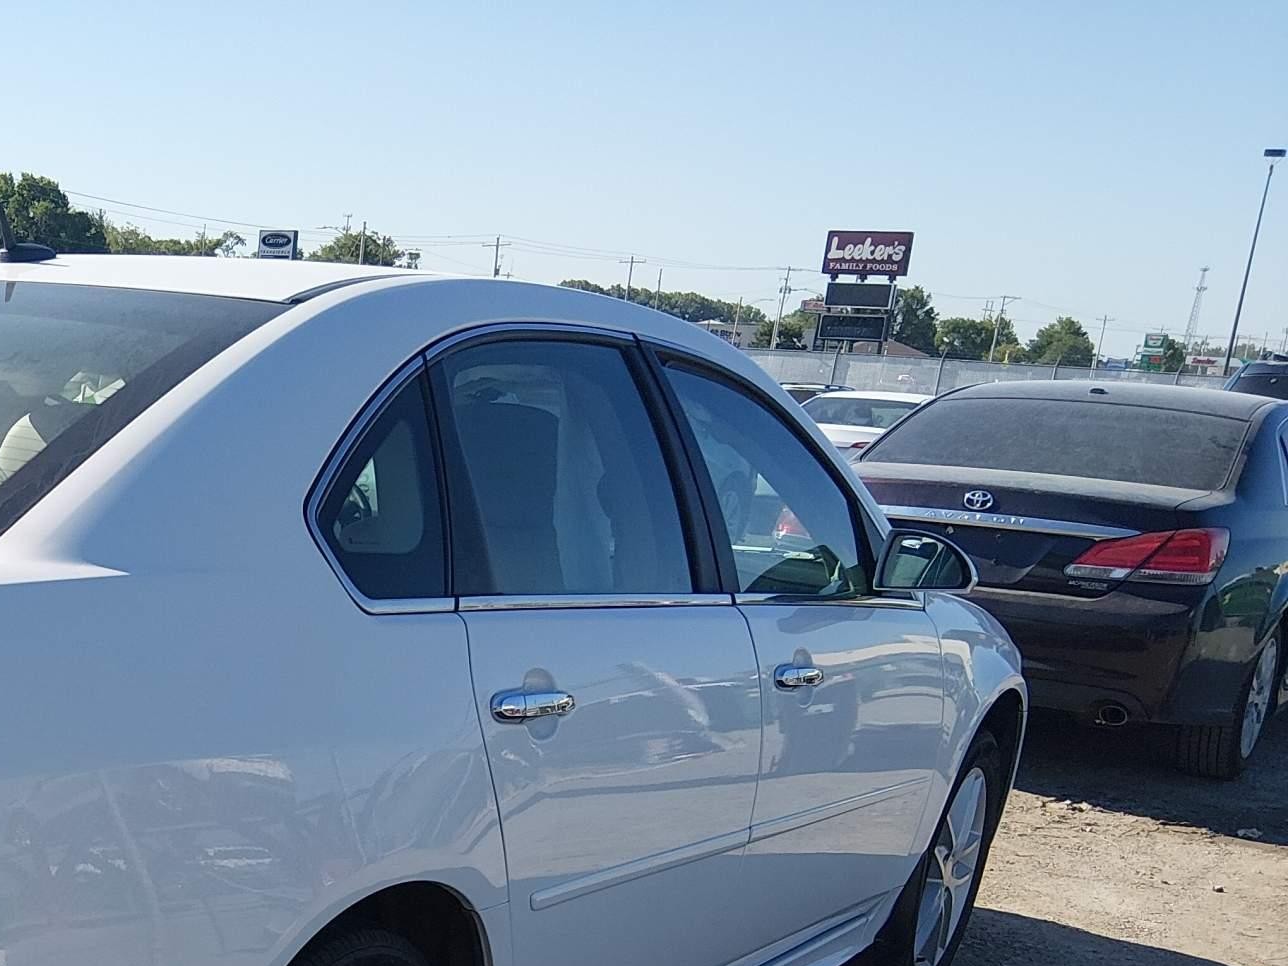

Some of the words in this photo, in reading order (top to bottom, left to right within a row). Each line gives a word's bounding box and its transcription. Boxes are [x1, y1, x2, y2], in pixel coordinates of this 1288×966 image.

[827, 236, 906, 262] Leeker's
[829, 262, 865, 270] FAMILY
[866, 263, 898, 271] FOODS
